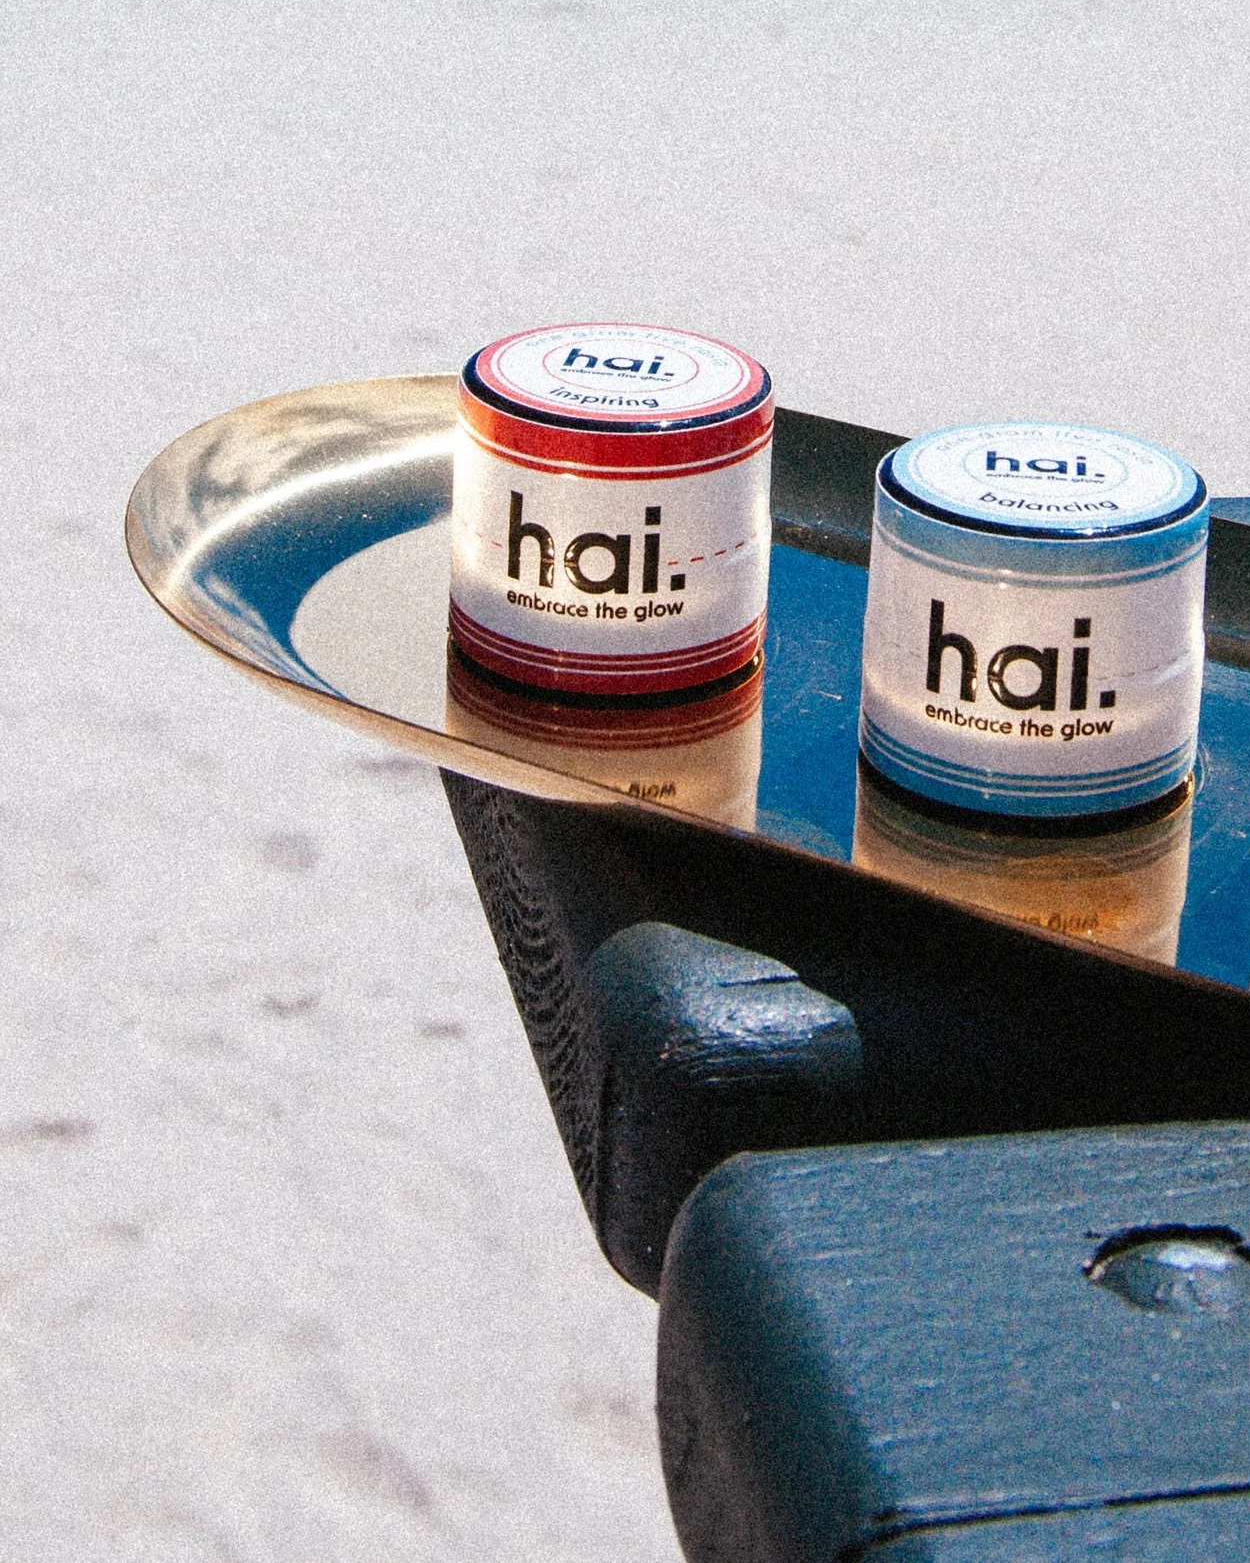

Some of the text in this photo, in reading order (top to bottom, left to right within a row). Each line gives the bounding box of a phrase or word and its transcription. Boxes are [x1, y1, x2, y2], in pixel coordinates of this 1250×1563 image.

[563, 348, 674, 377] hai.
[549, 386, 660, 408] inspiring
[986, 450, 1105, 478] hai.
[980, 492, 1120, 513] balancing
[507, 490, 686, 595] hai.
[506, 588, 684, 623] embrace the glow
[926, 598, 1117, 712] hai.
[925, 703, 1114, 742] embrace the glow
